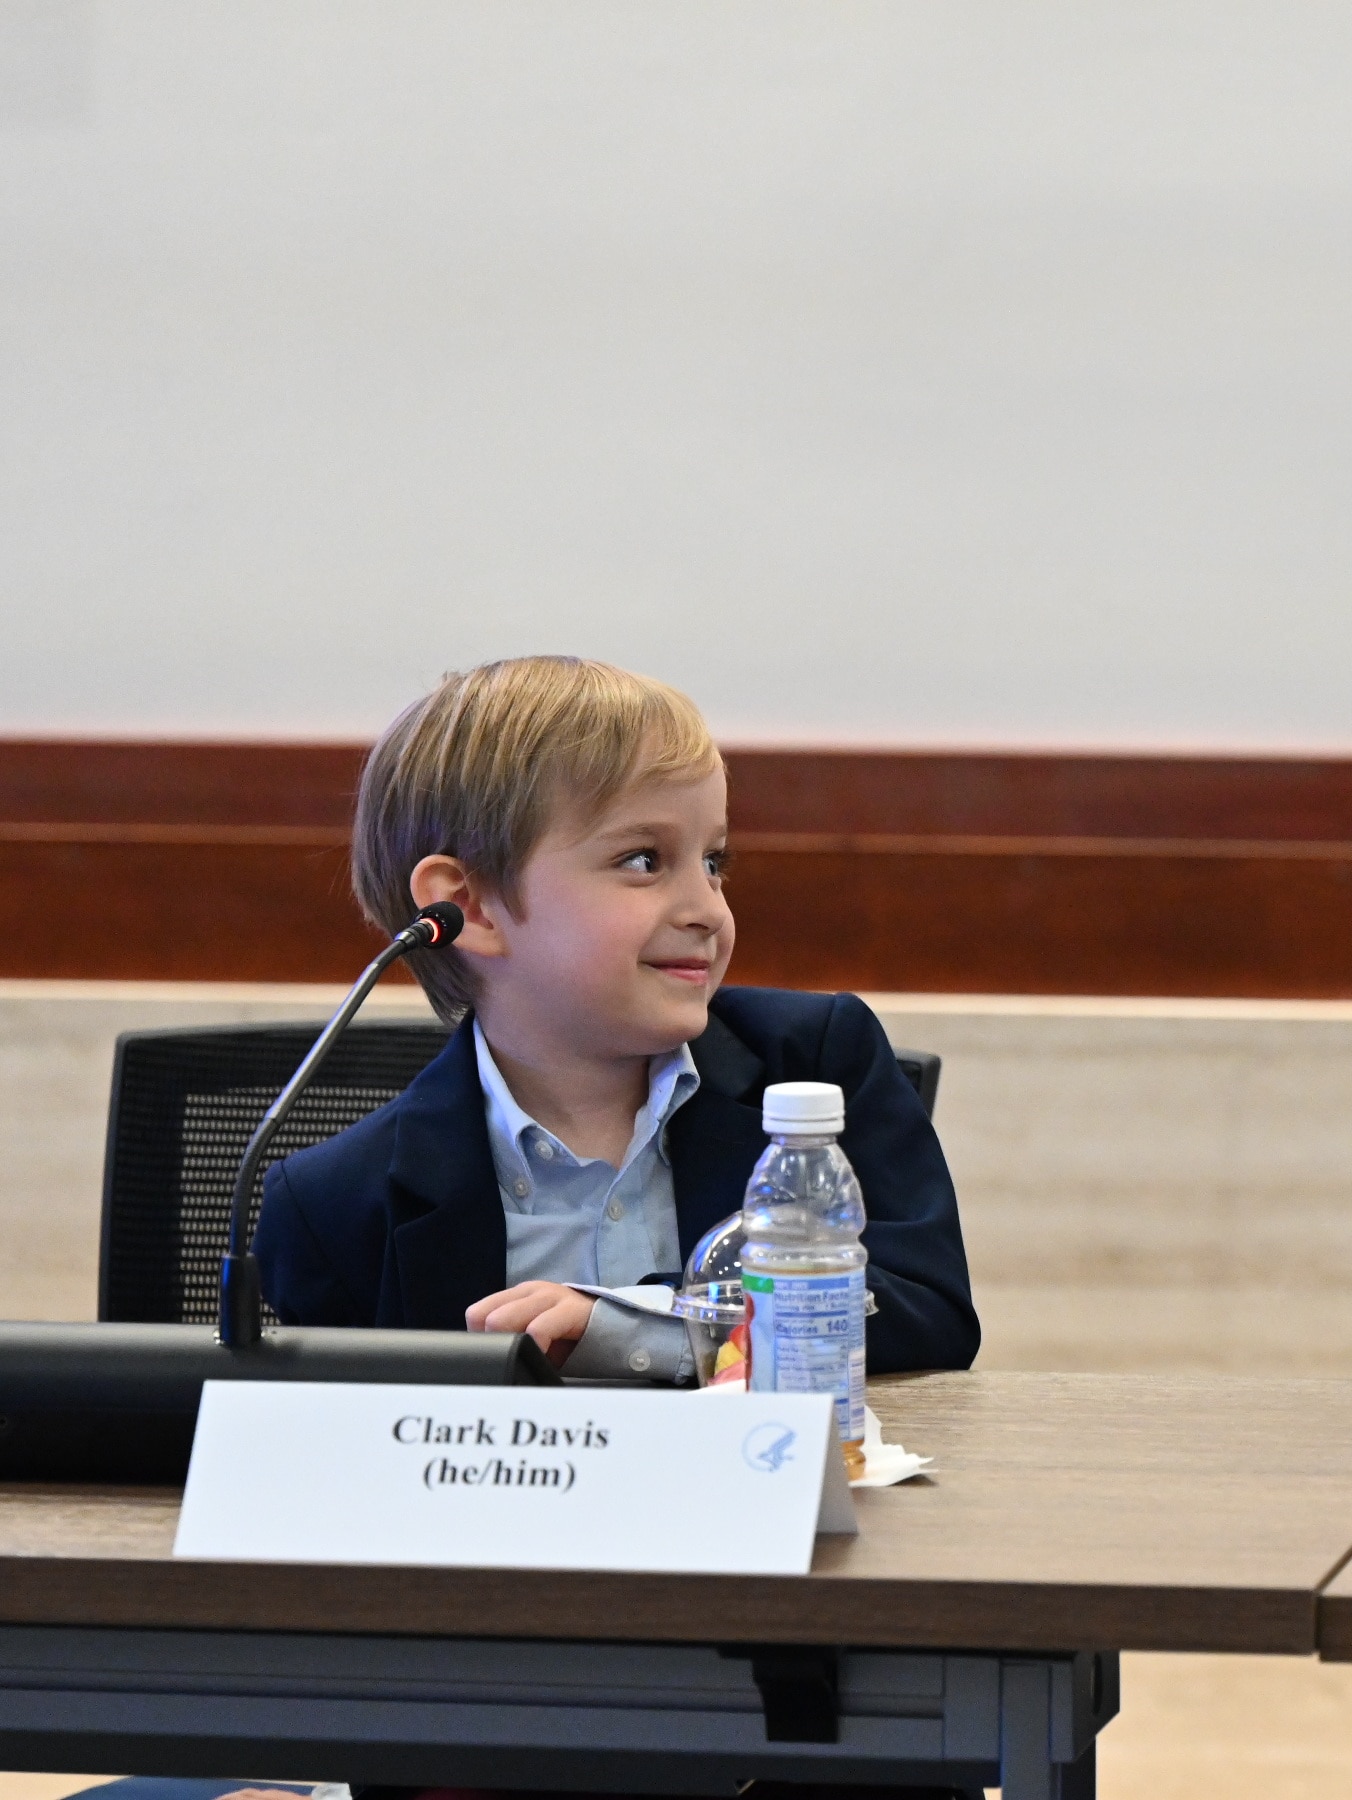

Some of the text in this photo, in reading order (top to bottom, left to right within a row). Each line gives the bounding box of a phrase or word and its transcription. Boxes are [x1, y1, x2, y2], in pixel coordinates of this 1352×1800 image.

[775, 1319, 849, 1334] Calories 140
[391, 1416, 610, 1448] Clark Davis
[422, 1457, 576, 1491] (he/him)
